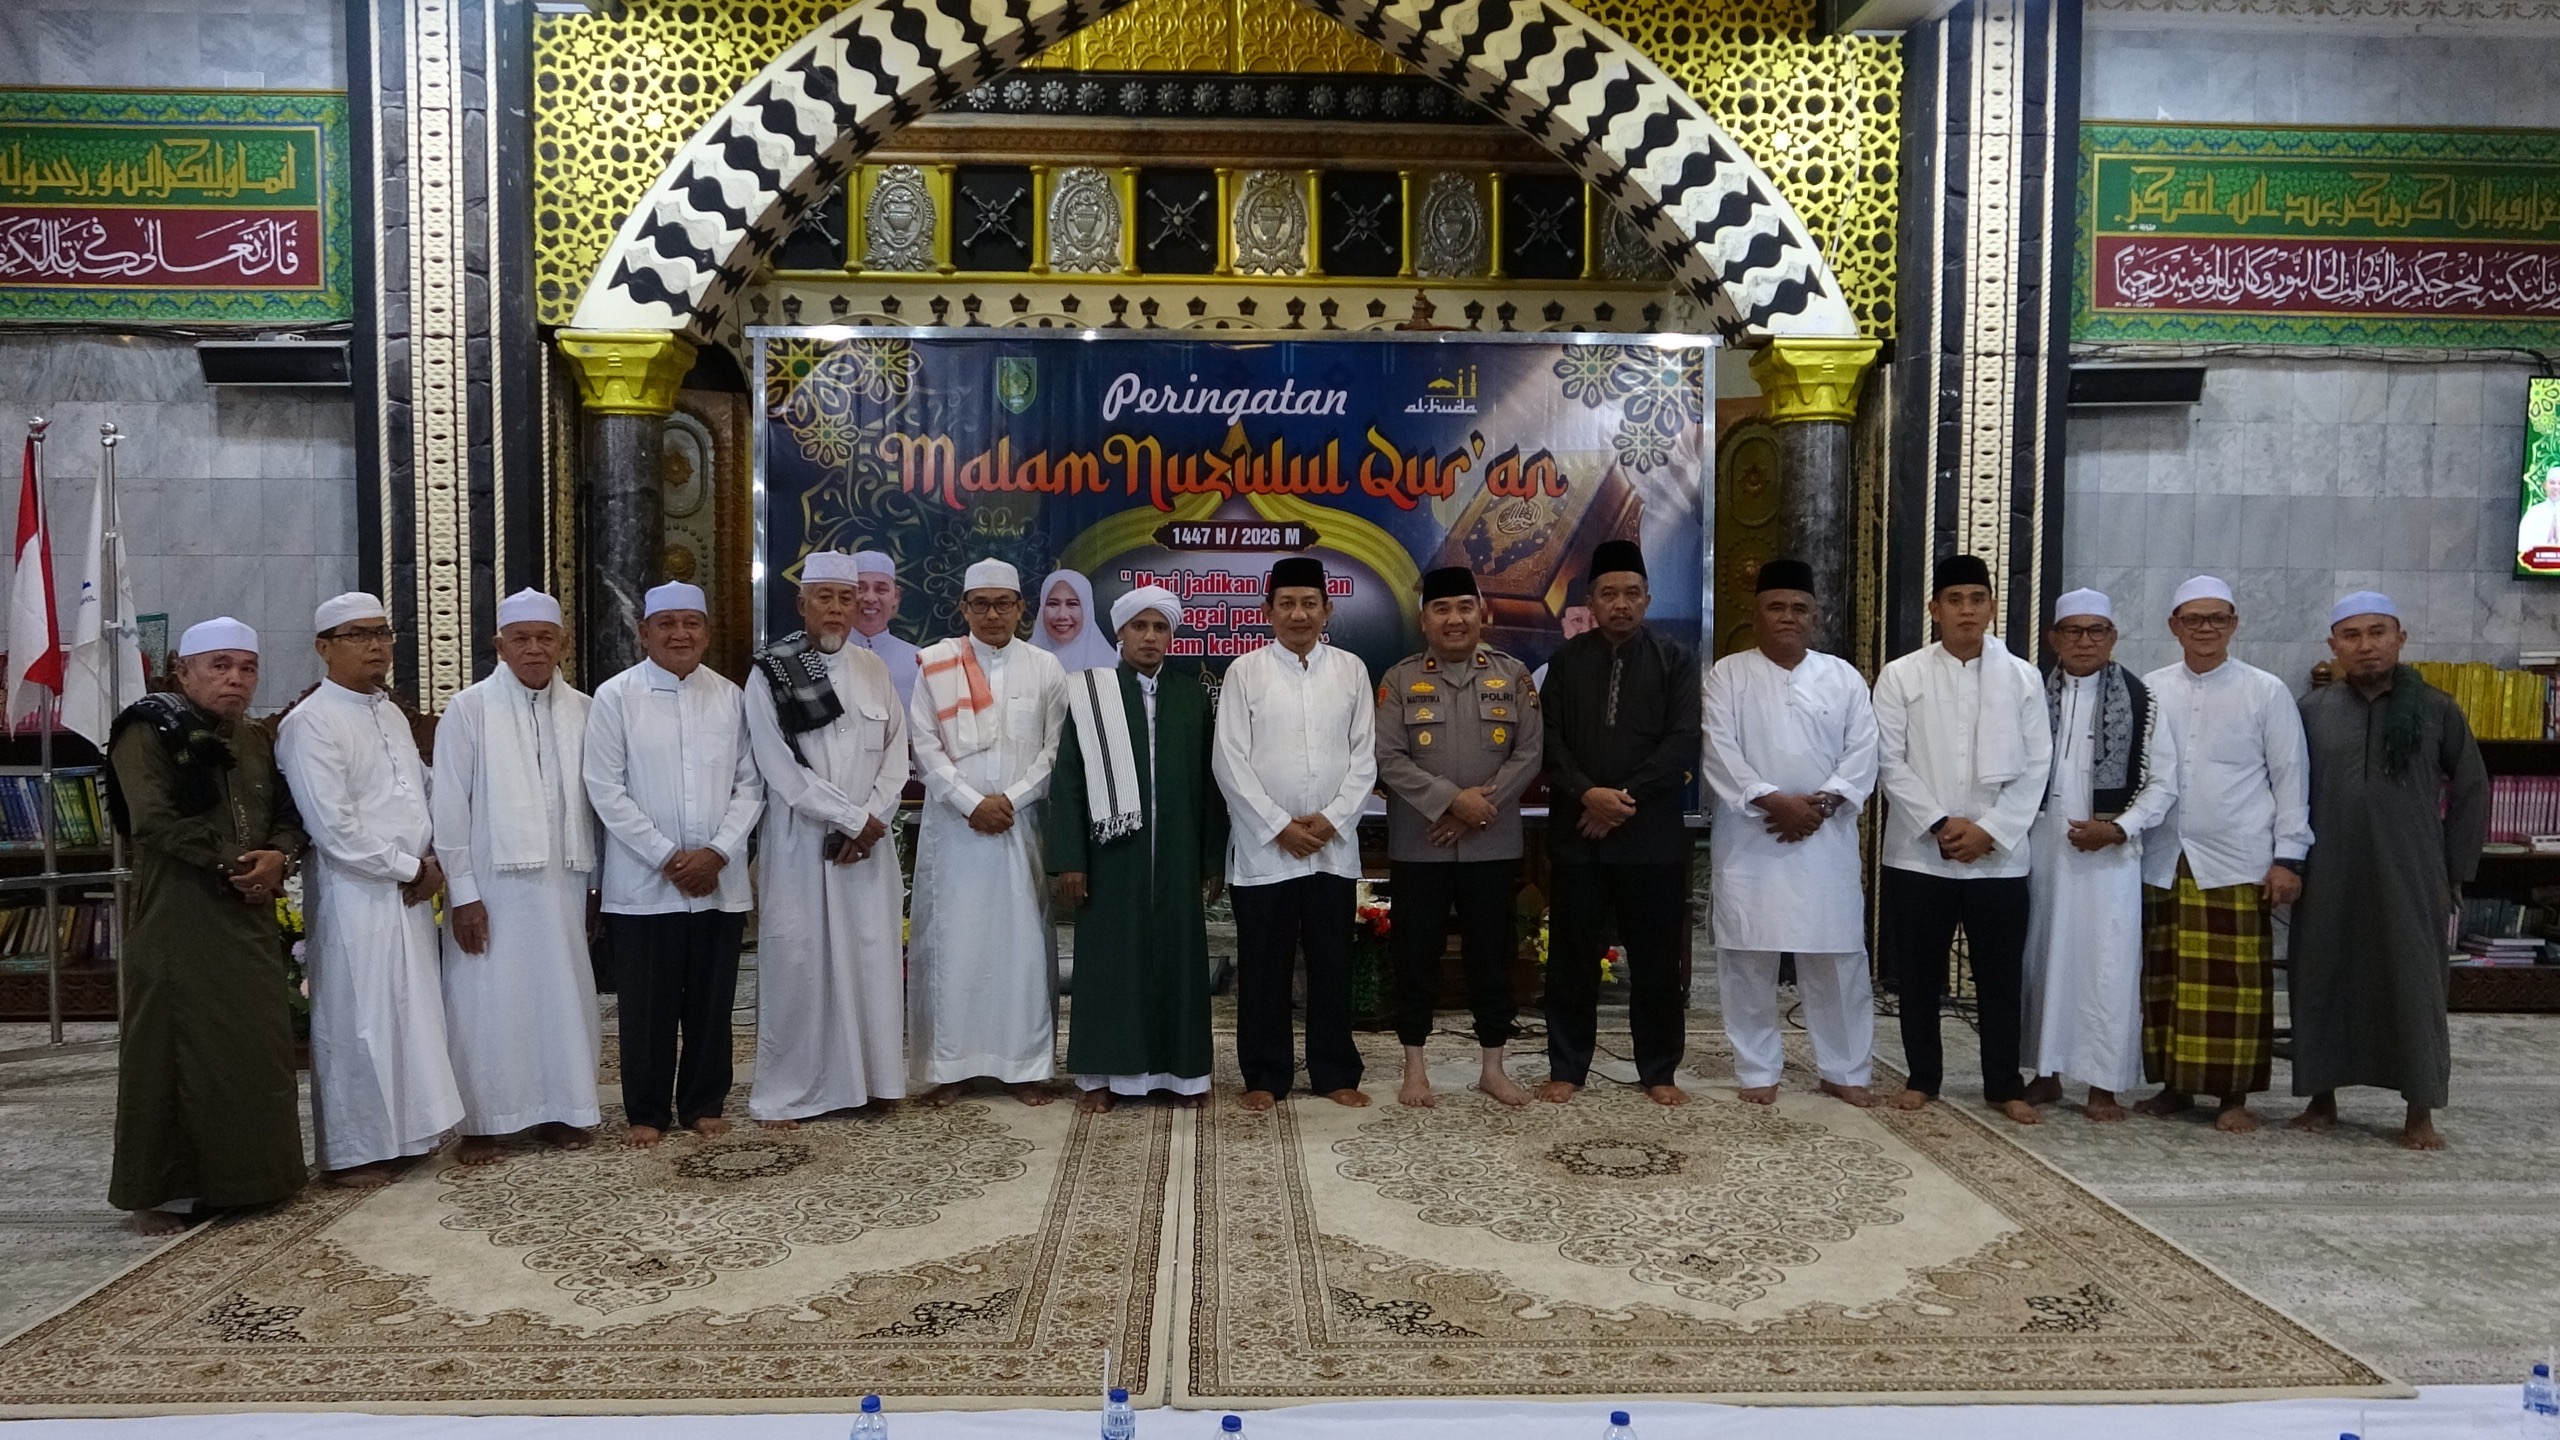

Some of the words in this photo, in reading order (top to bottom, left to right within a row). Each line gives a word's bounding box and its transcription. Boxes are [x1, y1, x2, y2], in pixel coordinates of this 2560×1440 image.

[1103, 373, 1348, 426] Peringatan
[879, 433, 1110, 510] Malam
[1103, 432, 1349, 512] Nuzulul
[1359, 424, 1569, 511] Qur'an
[1172, 527, 1211, 544] 1447
[1215, 527, 1227, 544] H
[1230, 527, 1237, 545] /
[1241, 527, 1281, 545] 2026
[1285, 527, 1300, 545] M
[1182, 571, 1258, 600] jadikan
[1481, 693, 1513, 701] POLRI
